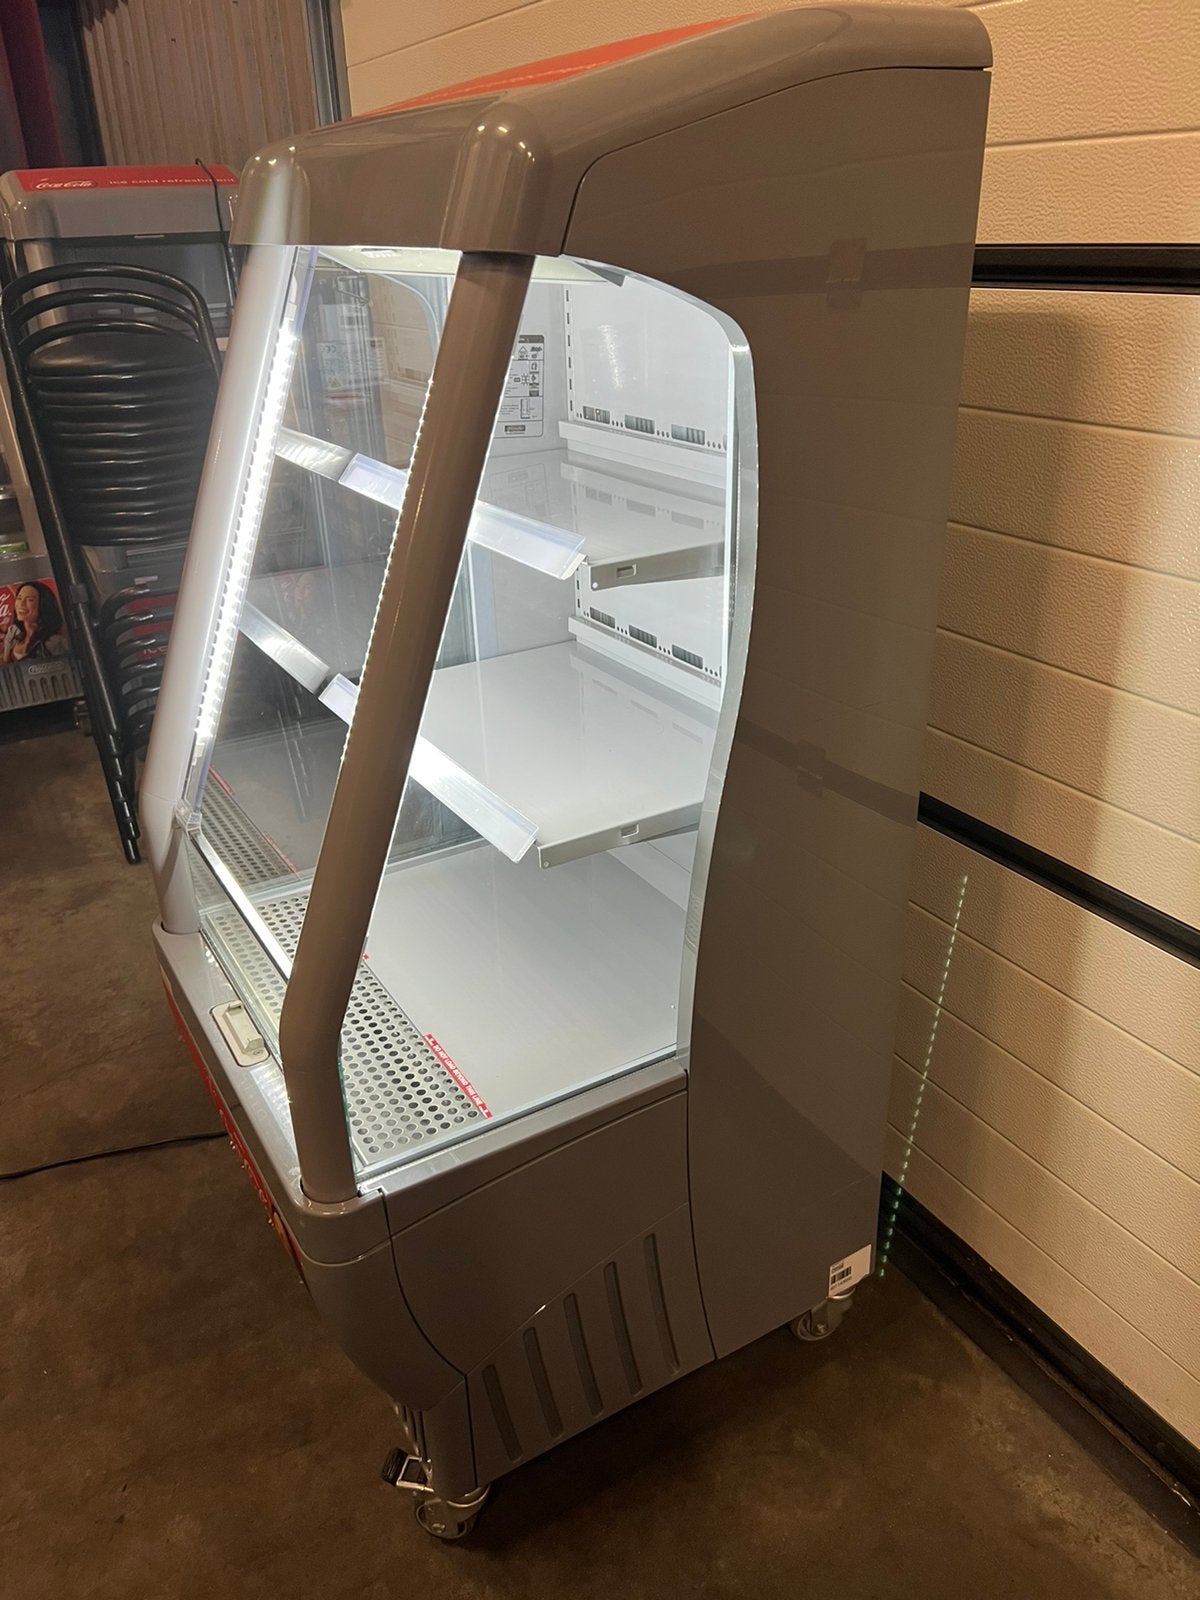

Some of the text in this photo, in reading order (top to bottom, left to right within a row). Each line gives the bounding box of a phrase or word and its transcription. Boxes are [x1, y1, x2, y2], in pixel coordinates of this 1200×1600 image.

[36, 178, 93, 190] Coca-Cola
[439, 1051, 448, 1059] NOT
[444, 1058, 456, 1070] LOAD
[453, 1068, 469, 1086] BEYOND
[465, 1084, 476, 1095] THIS
[472, 1094, 483, 1106] LINE
